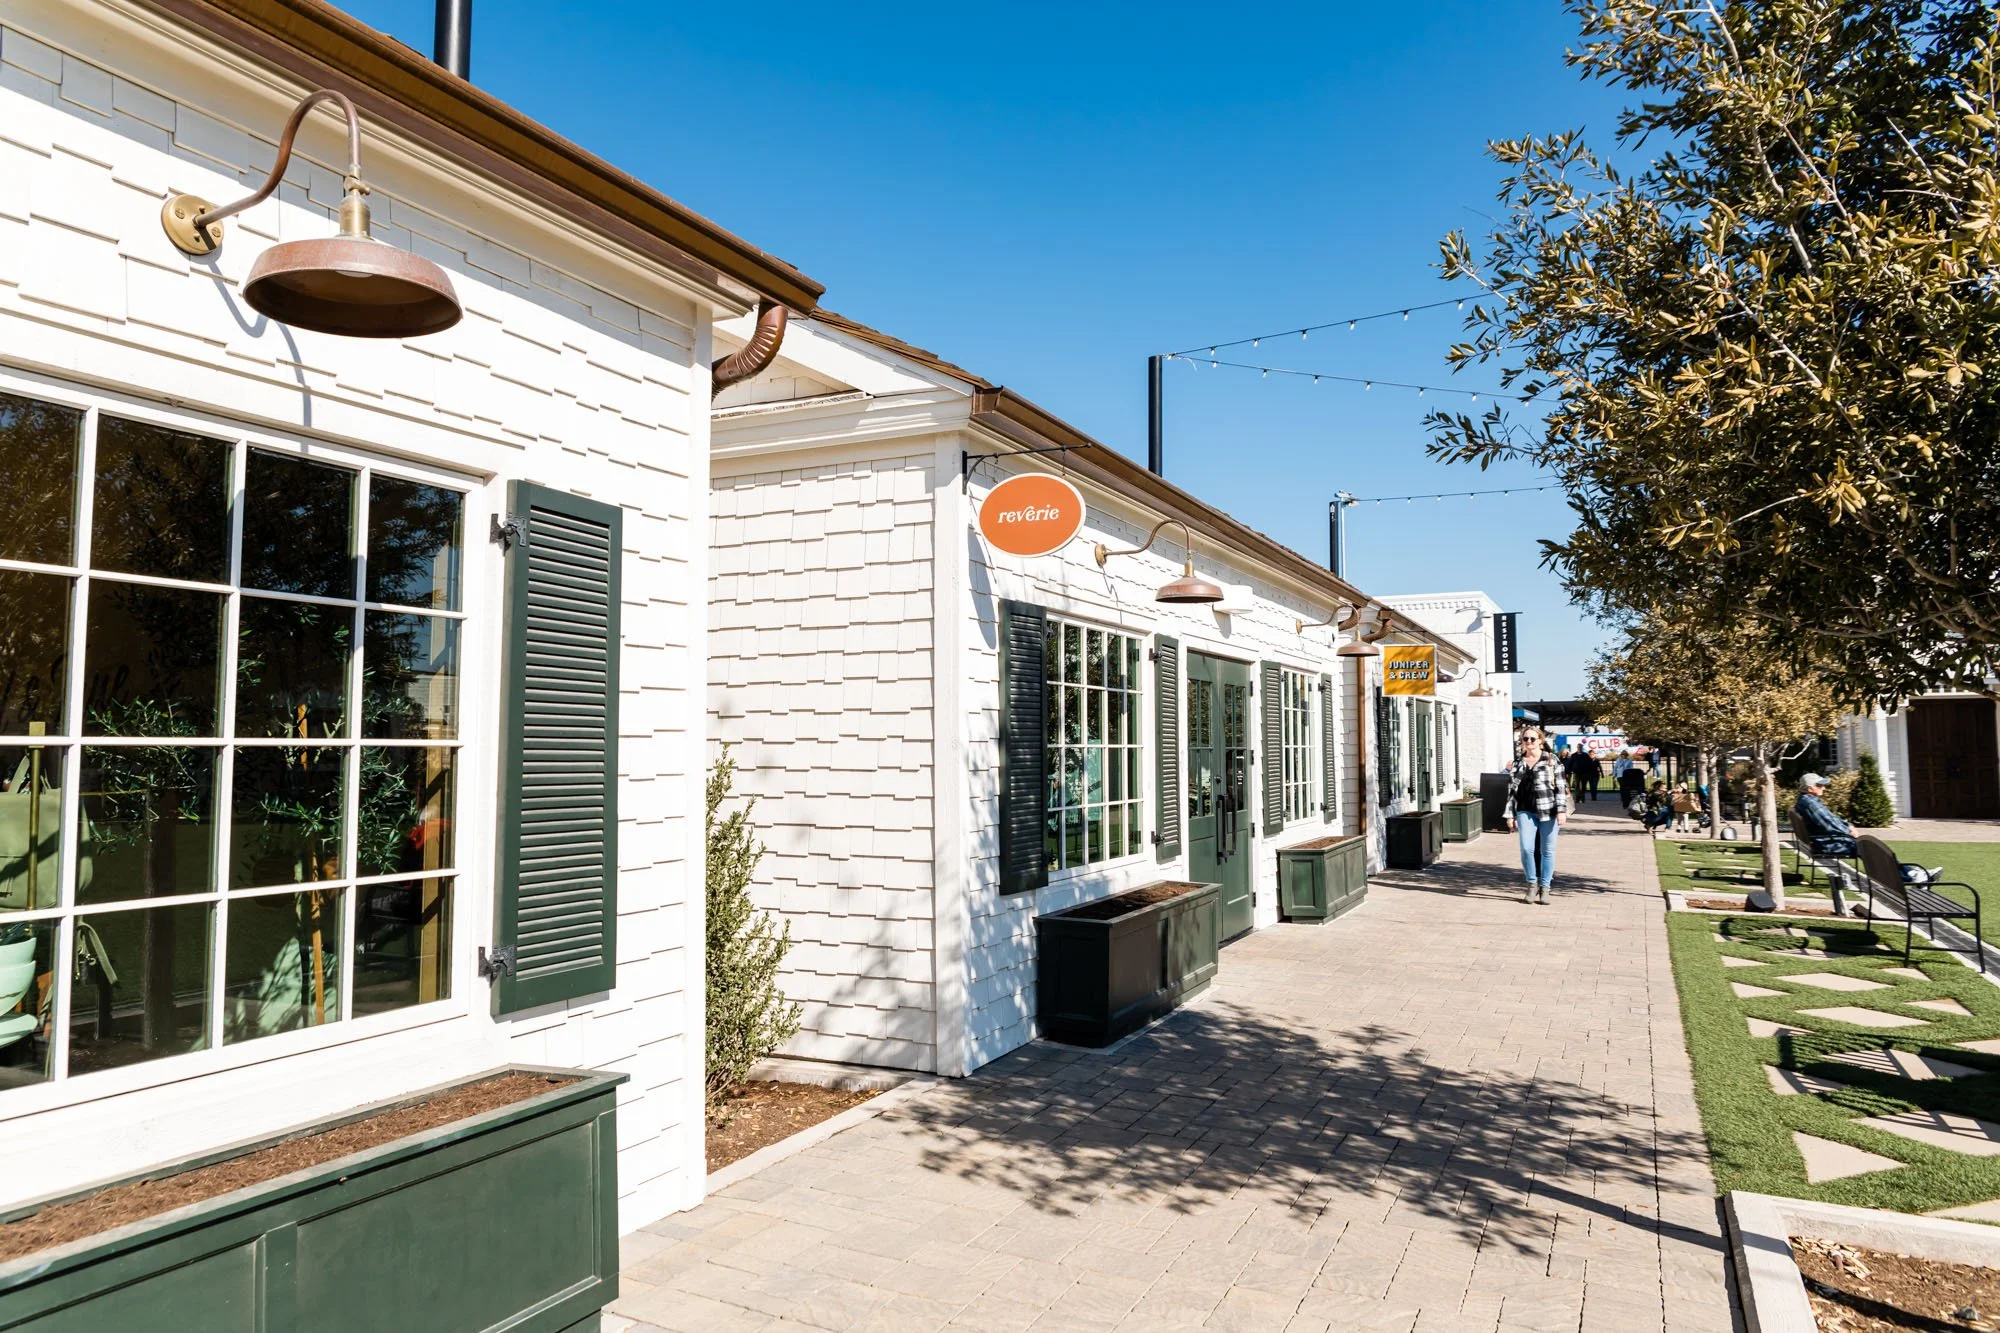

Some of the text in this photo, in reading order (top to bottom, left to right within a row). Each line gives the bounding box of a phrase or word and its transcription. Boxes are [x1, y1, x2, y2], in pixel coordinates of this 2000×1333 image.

[997, 504, 1060, 524] reverie
[1501, 615, 1509, 671] RESTROOMS
[1389, 660, 1429, 670] JUNIPER
[1389, 671, 1429, 680] & CREW
[1588, 738, 1621, 750] CLUB
